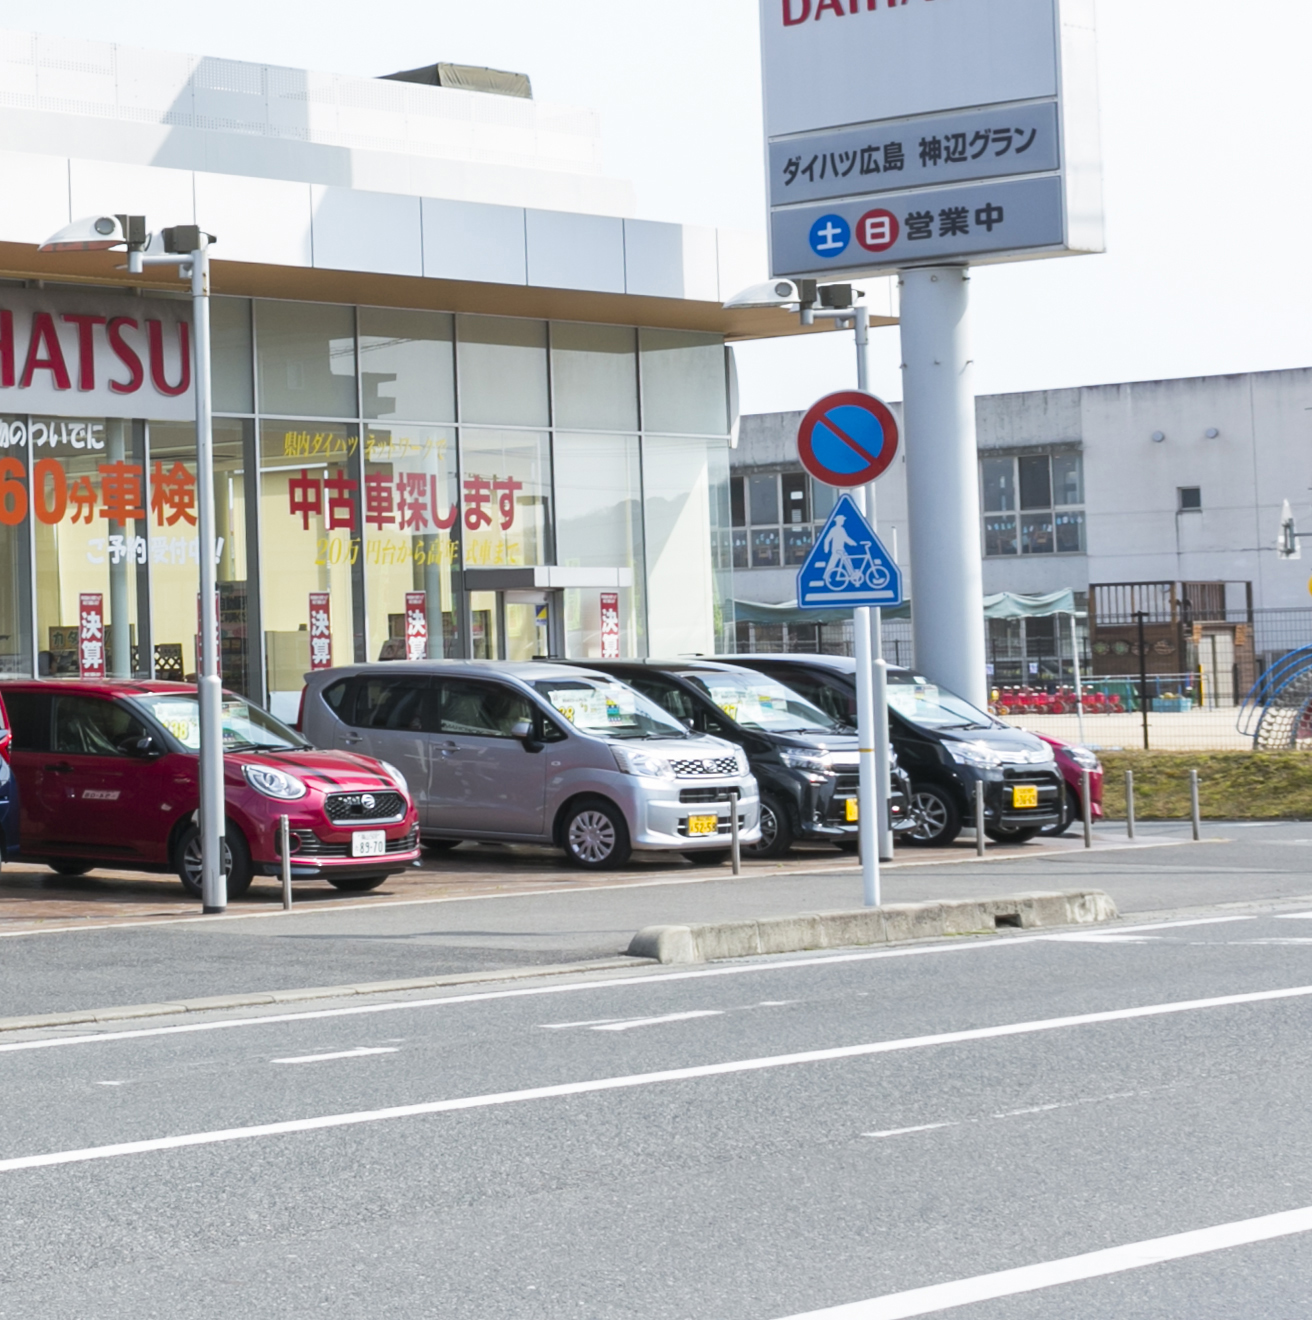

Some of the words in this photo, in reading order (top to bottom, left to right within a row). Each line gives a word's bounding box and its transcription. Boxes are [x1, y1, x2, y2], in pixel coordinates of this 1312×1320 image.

[783, 141, 905, 186] ダイハツ広島
[918, 127, 1037, 168] 神辺グラン
[816, 221, 844, 251] 土
[864, 216, 891, 245] 日
[904, 202, 1004, 242] 営業中
[288, 469, 523, 531] 中古車探します
[81, 611, 103, 669] 決算
[311, 610, 330, 664] 決算
